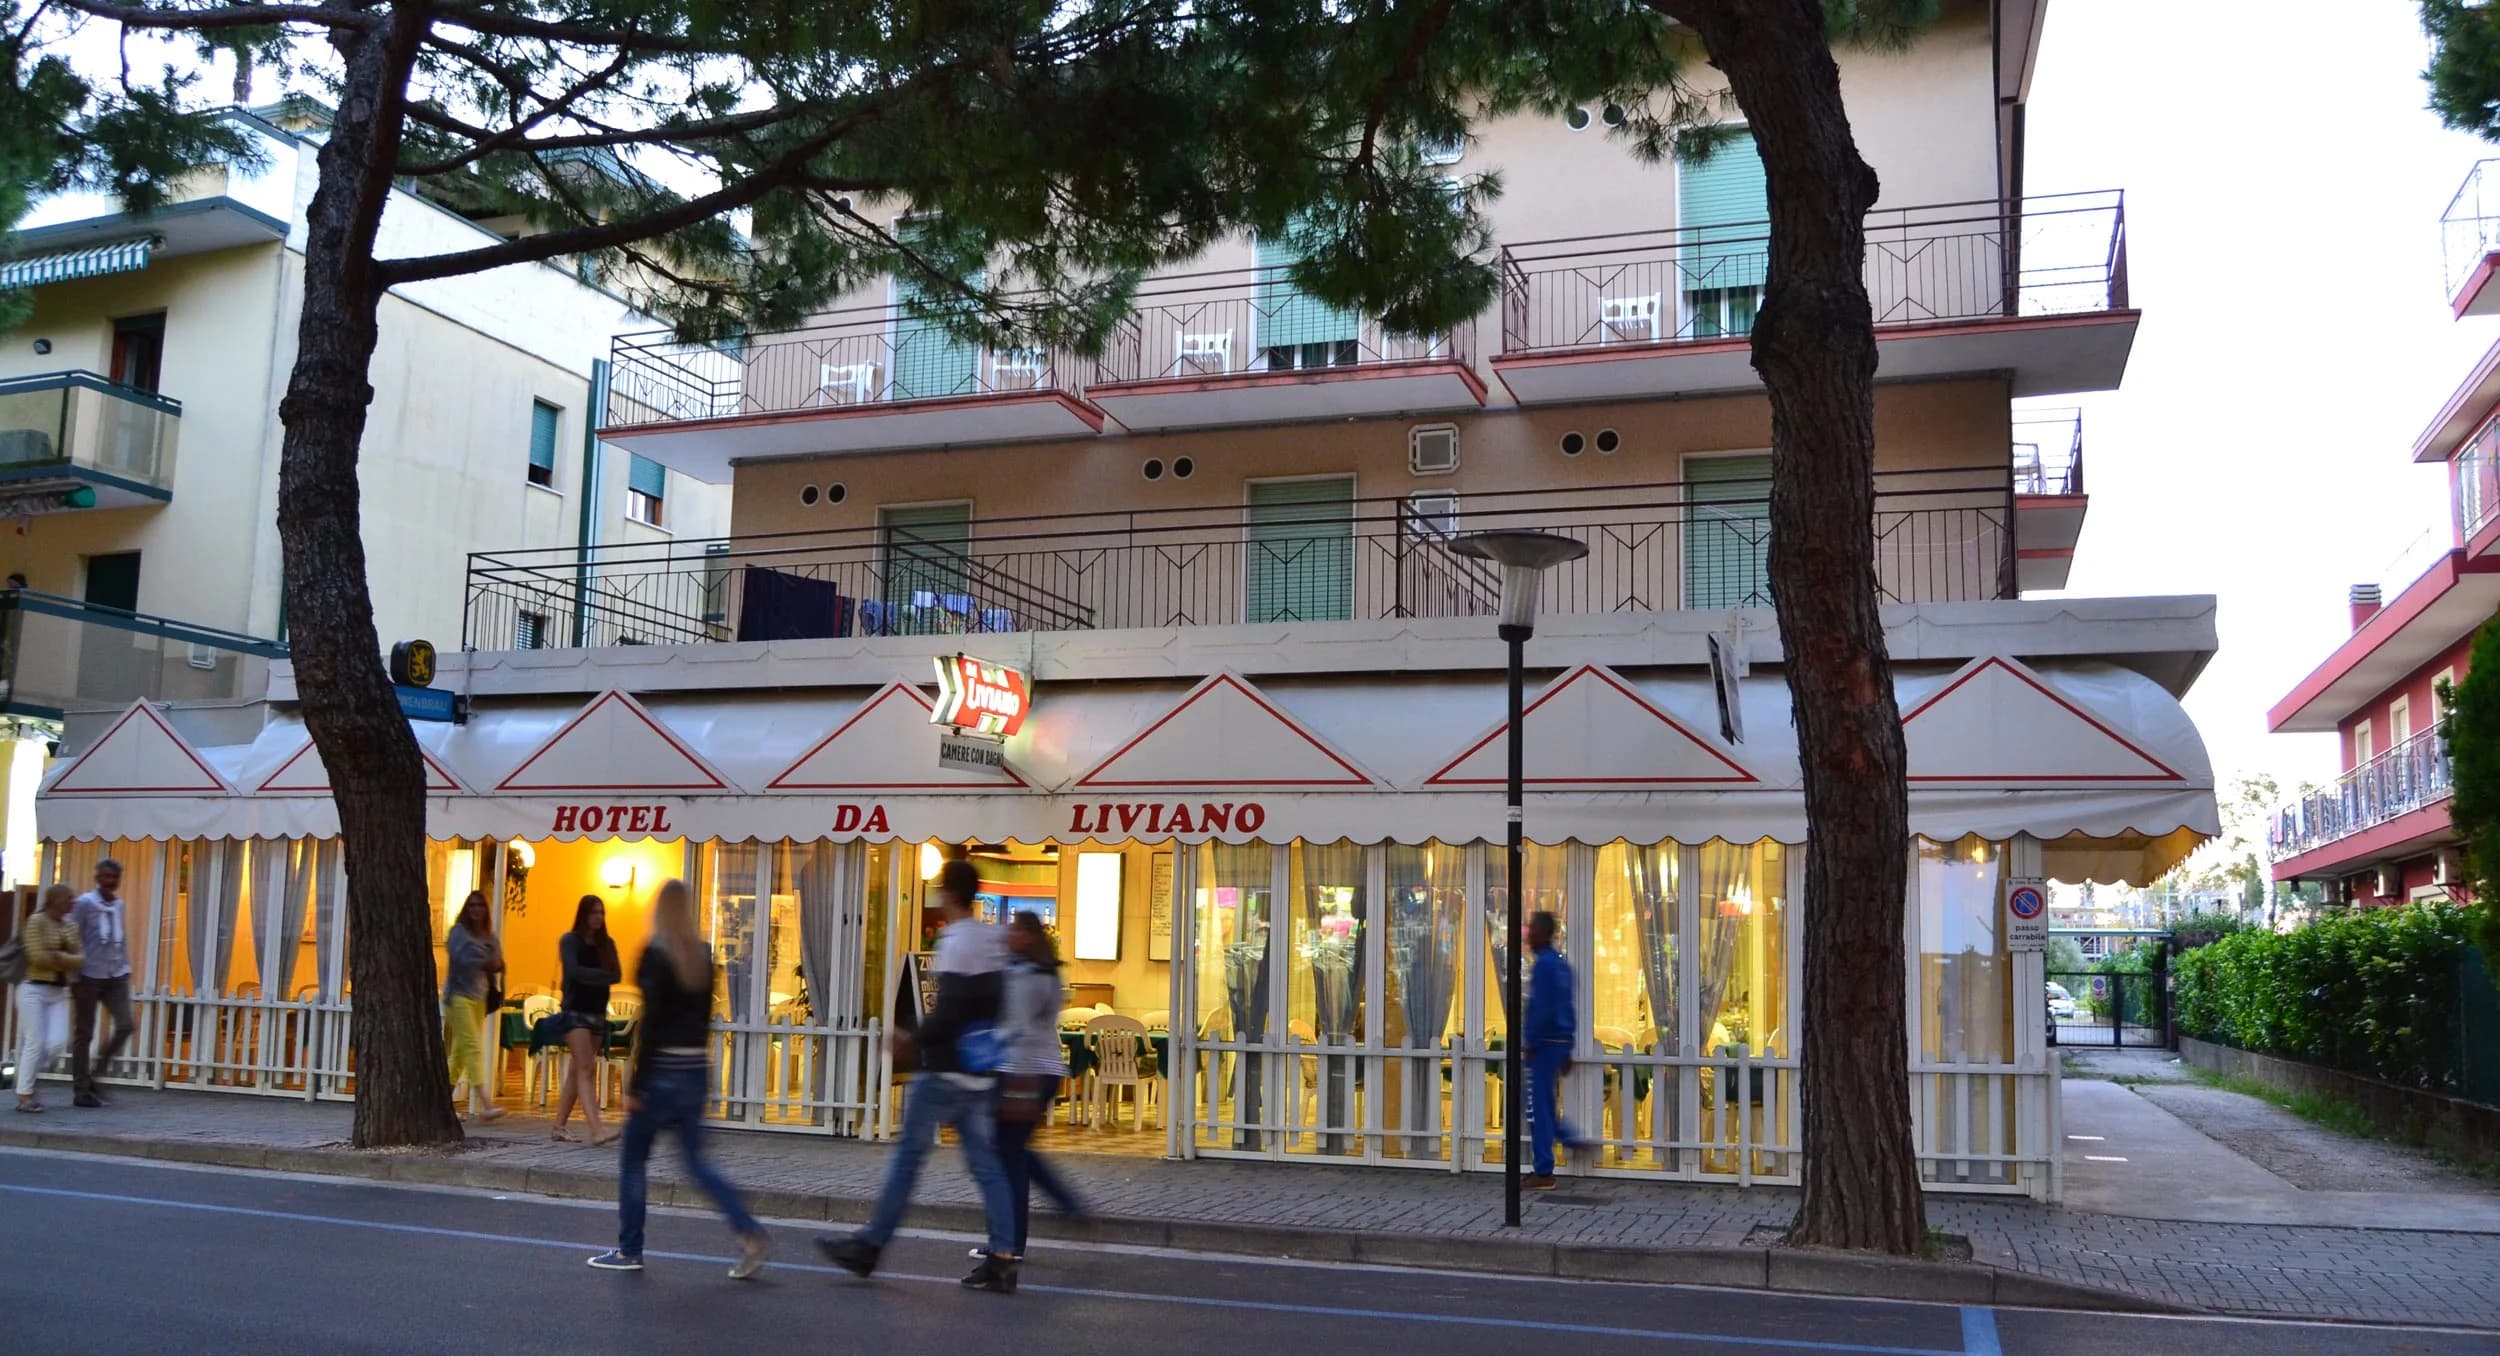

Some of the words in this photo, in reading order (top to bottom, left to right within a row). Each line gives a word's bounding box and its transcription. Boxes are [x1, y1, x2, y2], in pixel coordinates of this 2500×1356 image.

[941, 742, 970, 763] CAMERE
[970, 747, 985, 765] CON
[552, 805, 672, 833] HOTEL
[832, 804, 890, 833] DA
[1068, 803, 1266, 833] LIVIANO
[2009, 933, 2046, 941] carrabile
